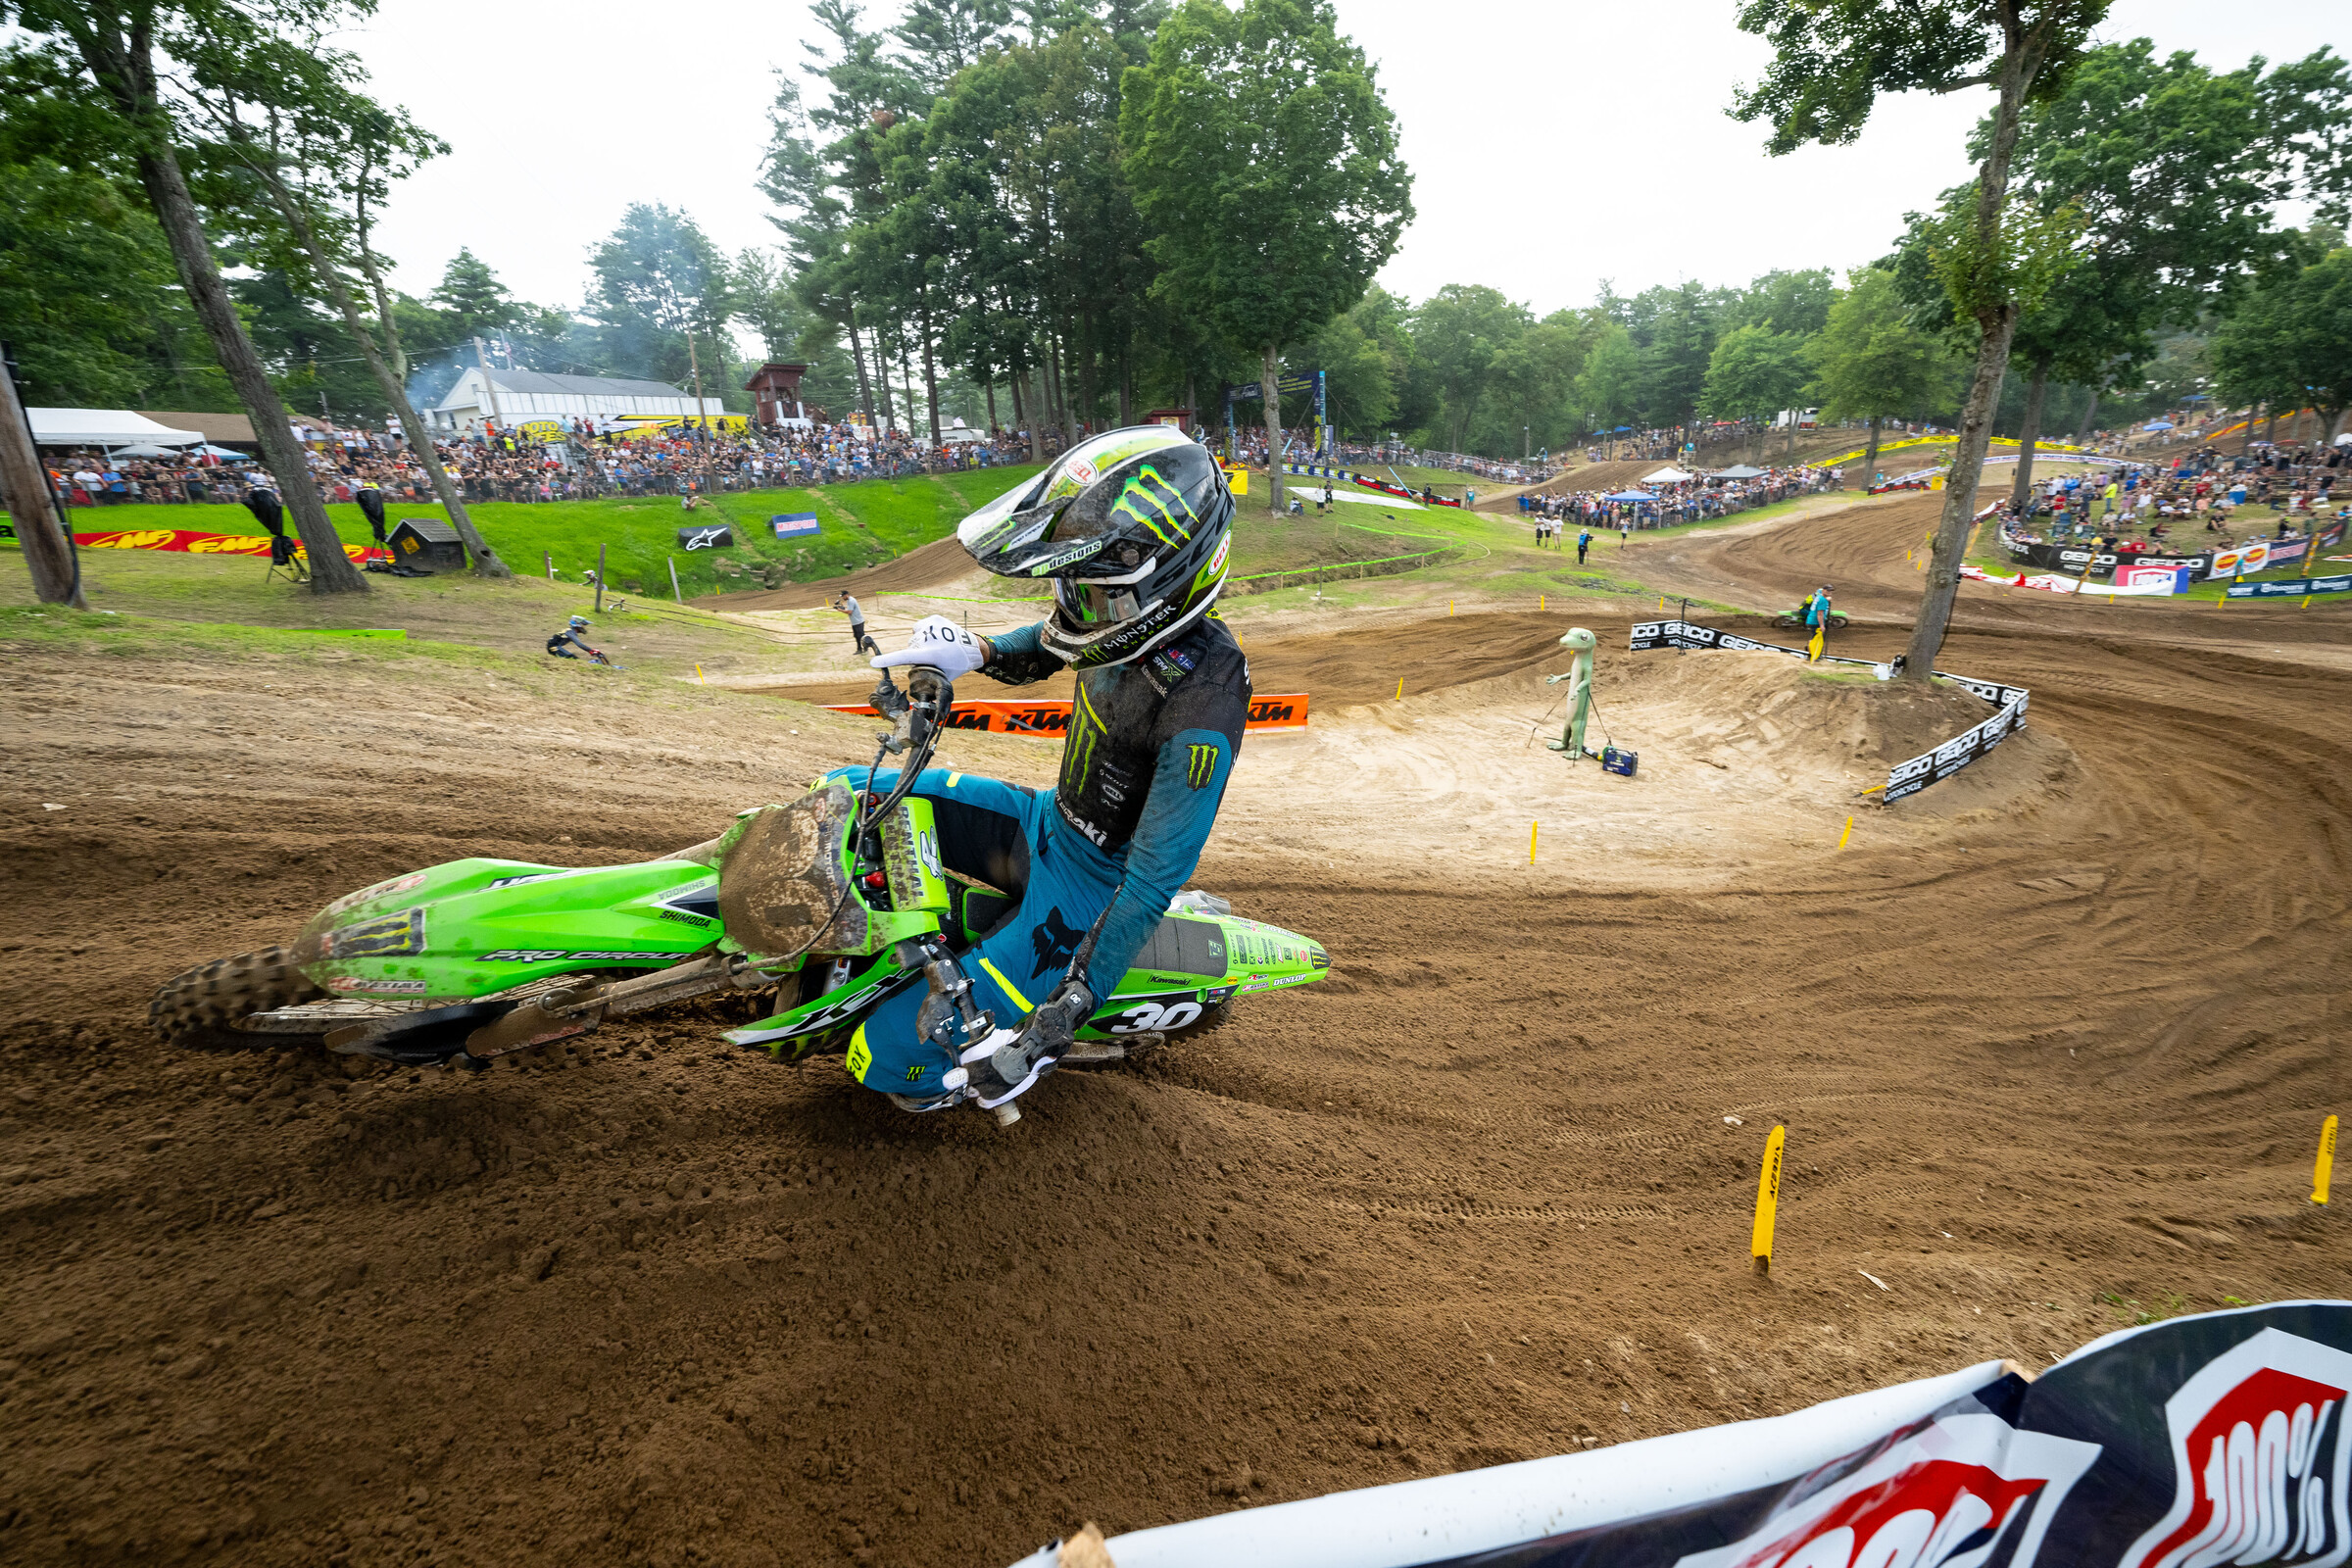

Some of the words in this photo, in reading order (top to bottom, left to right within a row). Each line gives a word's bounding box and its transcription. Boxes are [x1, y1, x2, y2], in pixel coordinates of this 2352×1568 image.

[1031, 541, 1102, 577] apdesigns
[1212, 539, 1230, 570] BELL
[922, 624, 972, 646] FOX
[1103, 604, 1177, 650] MONSTER
[1122, 617, 1170, 650] ENERGY
[1631, 625, 1660, 639] ICO
[1663, 622, 1715, 642] GEICO
[1005, 709, 1074, 731] KTM
[1935, 730, 1981, 766] GEICO
[901, 806, 925, 902] RENTHAL
[658, 880, 706, 901] SHIMODA
[660, 909, 711, 928] SHIMODA
[480, 949, 567, 963] PRO
[1151, 975, 1193, 986] Kawasaki
[1272, 973, 1307, 987] DUNLOP
[1110, 1002, 1202, 1035] 30
